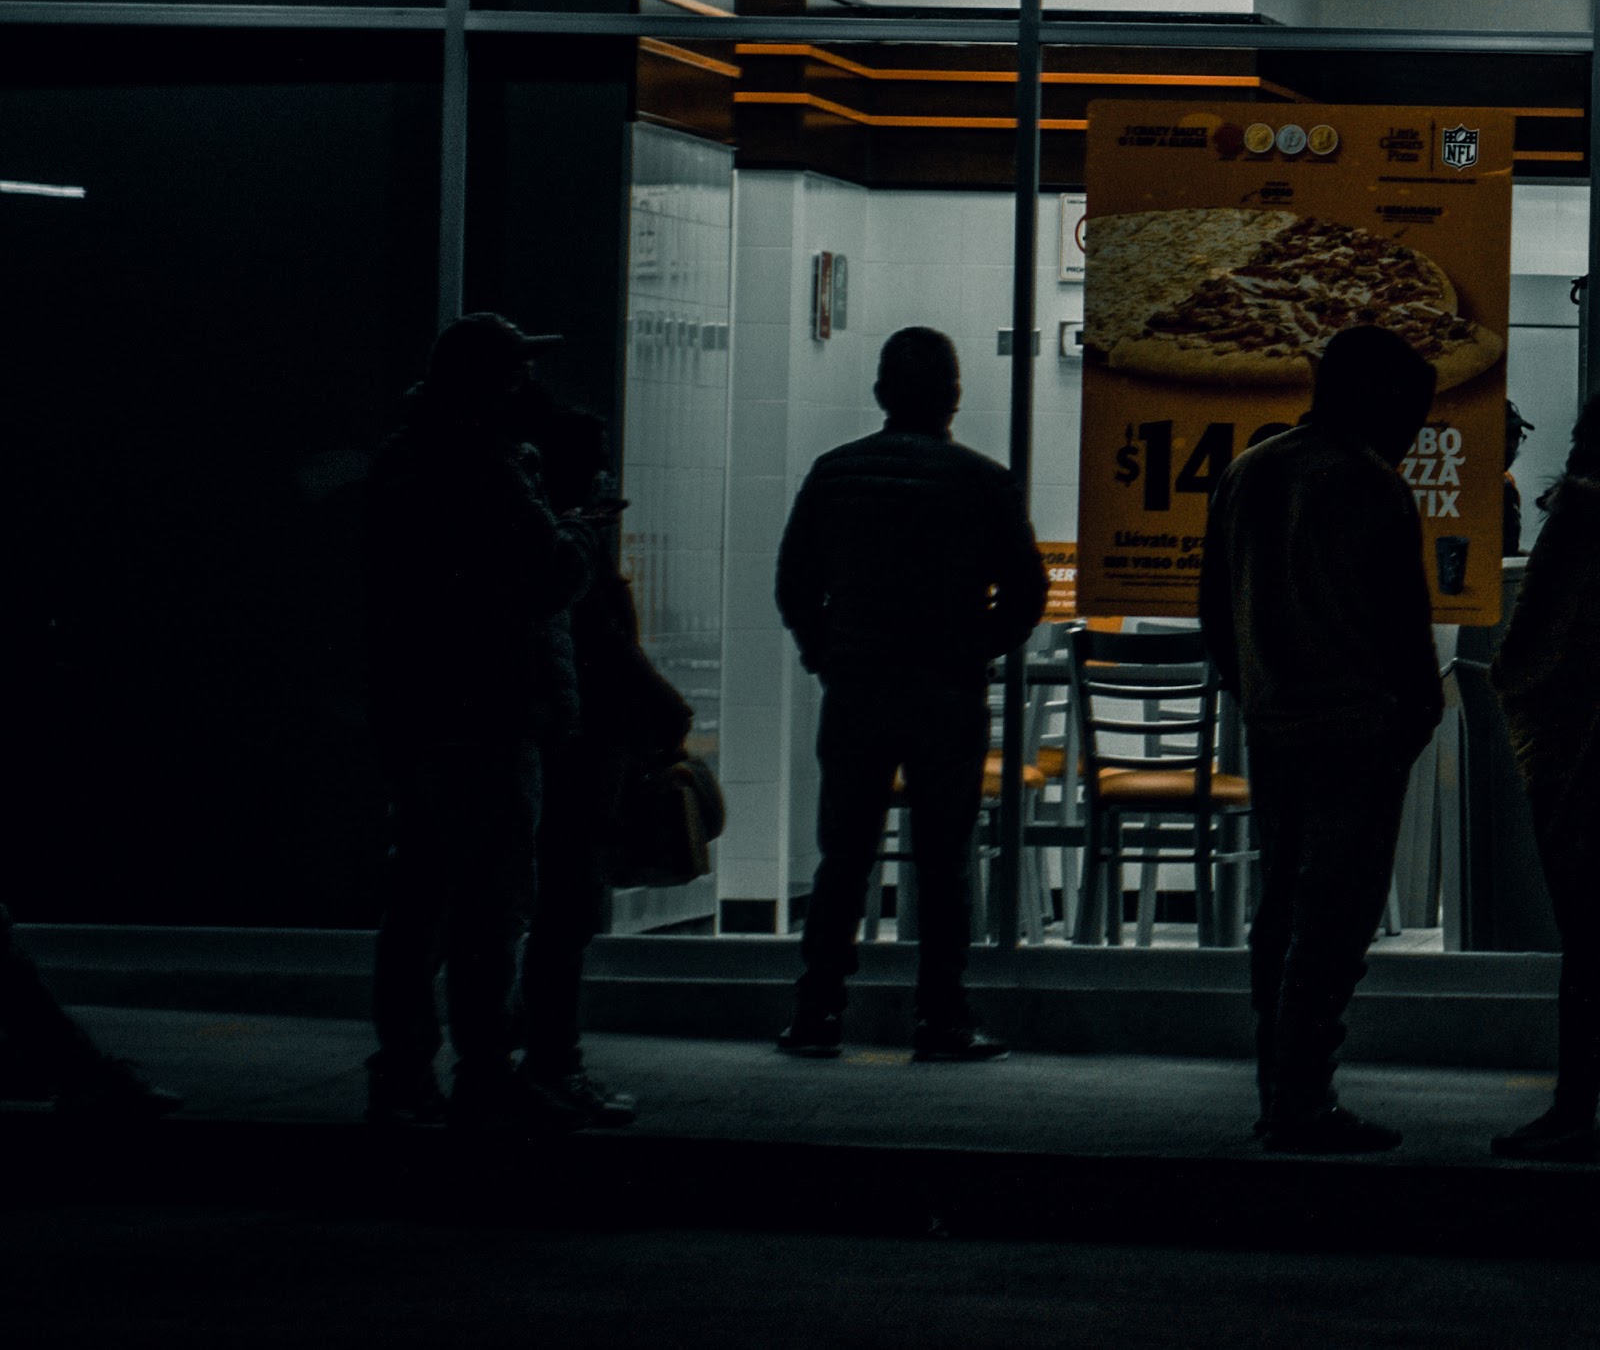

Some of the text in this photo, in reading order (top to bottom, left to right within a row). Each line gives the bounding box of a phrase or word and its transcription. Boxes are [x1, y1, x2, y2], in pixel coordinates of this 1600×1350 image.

[1446, 144, 1474, 163] NFL
[1407, 427, 1463, 457] BO
[1114, 420, 1297, 512] $14
[1115, 530, 1178, 548] Llévate
[1133, 556, 1172, 569] vaso
